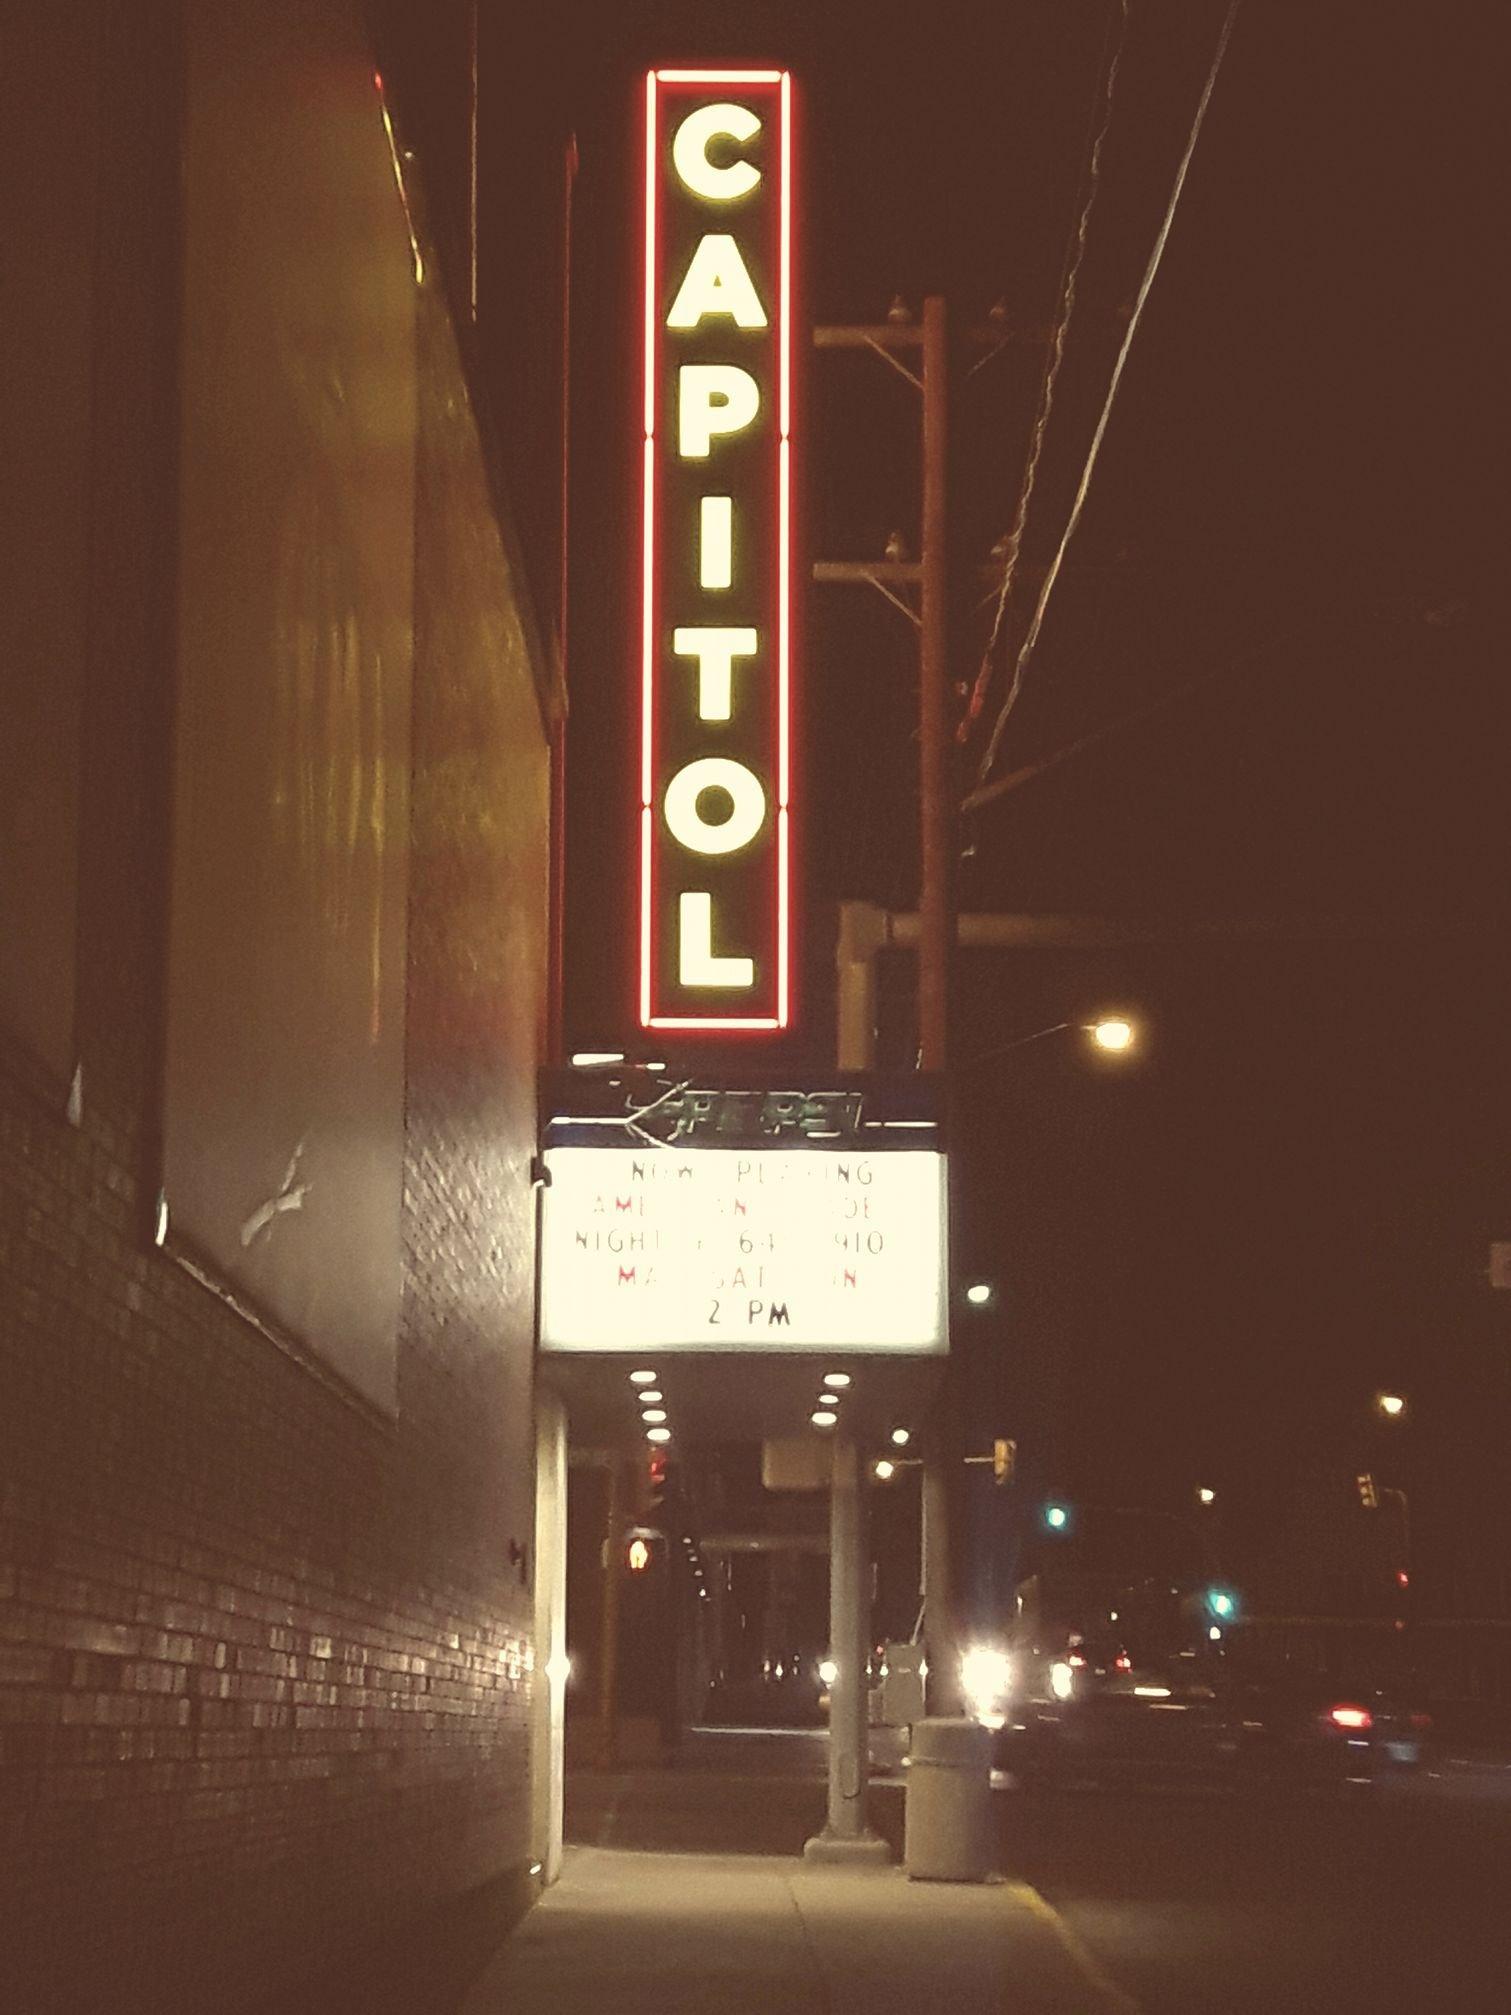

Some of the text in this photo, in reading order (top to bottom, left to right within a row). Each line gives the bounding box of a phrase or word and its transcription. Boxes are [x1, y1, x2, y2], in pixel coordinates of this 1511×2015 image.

[663, 103, 769, 986] CAPITOL
[738, 1160, 873, 1185] PLING
[709, 1299, 792, 1327] 2 PM
